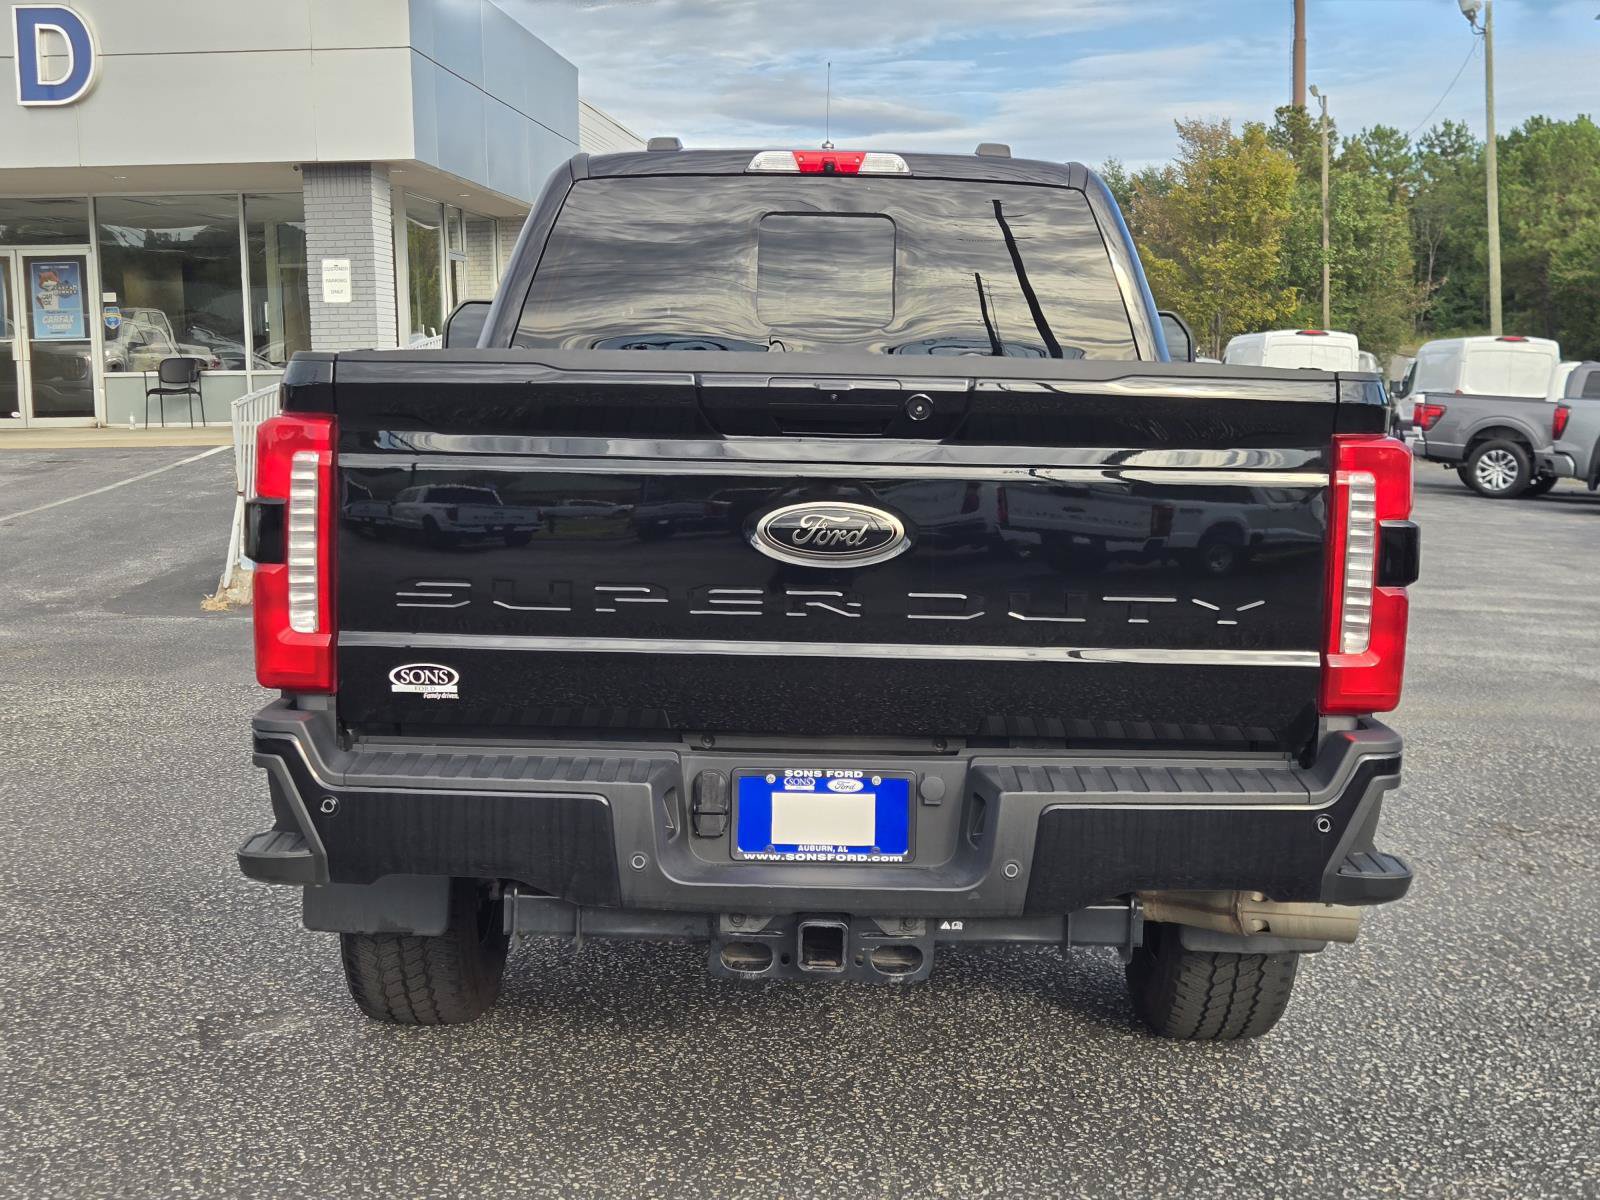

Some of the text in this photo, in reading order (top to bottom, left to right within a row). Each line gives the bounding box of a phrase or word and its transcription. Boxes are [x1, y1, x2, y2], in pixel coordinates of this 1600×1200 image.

[13, 4, 98, 107] D
[792, 514, 870, 547] Ford
[396, 577, 1267, 626] SUPER DUTY
[400, 669, 449, 685] SONS
[784, 769, 864, 779] SONS FORD
[788, 777, 811, 787] SONS
[834, 780, 857, 791] Ford
[797, 844, 849, 853] AUBURN, AL
[743, 853, 903, 863] www.SONSFORD.com
